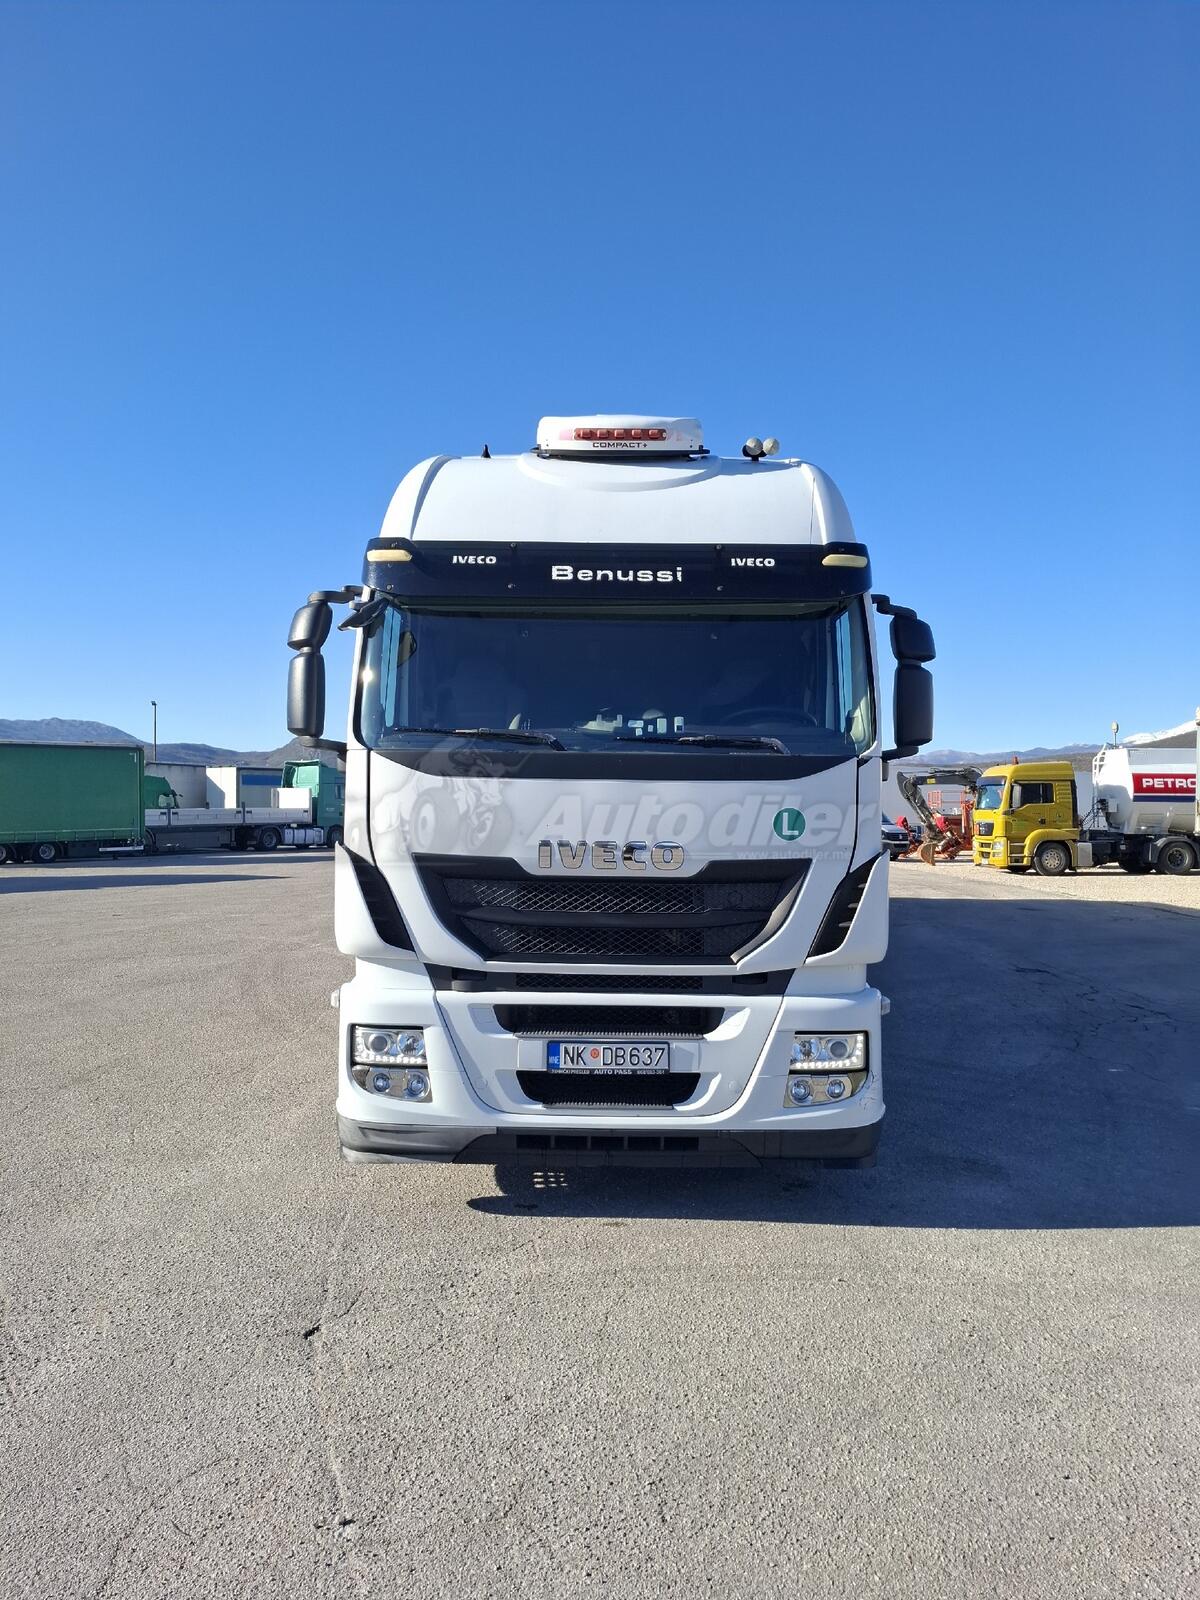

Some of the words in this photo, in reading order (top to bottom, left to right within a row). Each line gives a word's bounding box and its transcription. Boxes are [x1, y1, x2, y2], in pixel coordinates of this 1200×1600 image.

[592, 441, 648, 449] COMPACT+
[452, 555, 497, 565] IVECO
[730, 557, 776, 567] IVECO
[551, 565, 683, 583] Benussi
[782, 812, 799, 836] L
[538, 839, 686, 871] IVECO
[562, 1045, 587, 1067] NK
[600, 1046, 666, 1067] DB637
